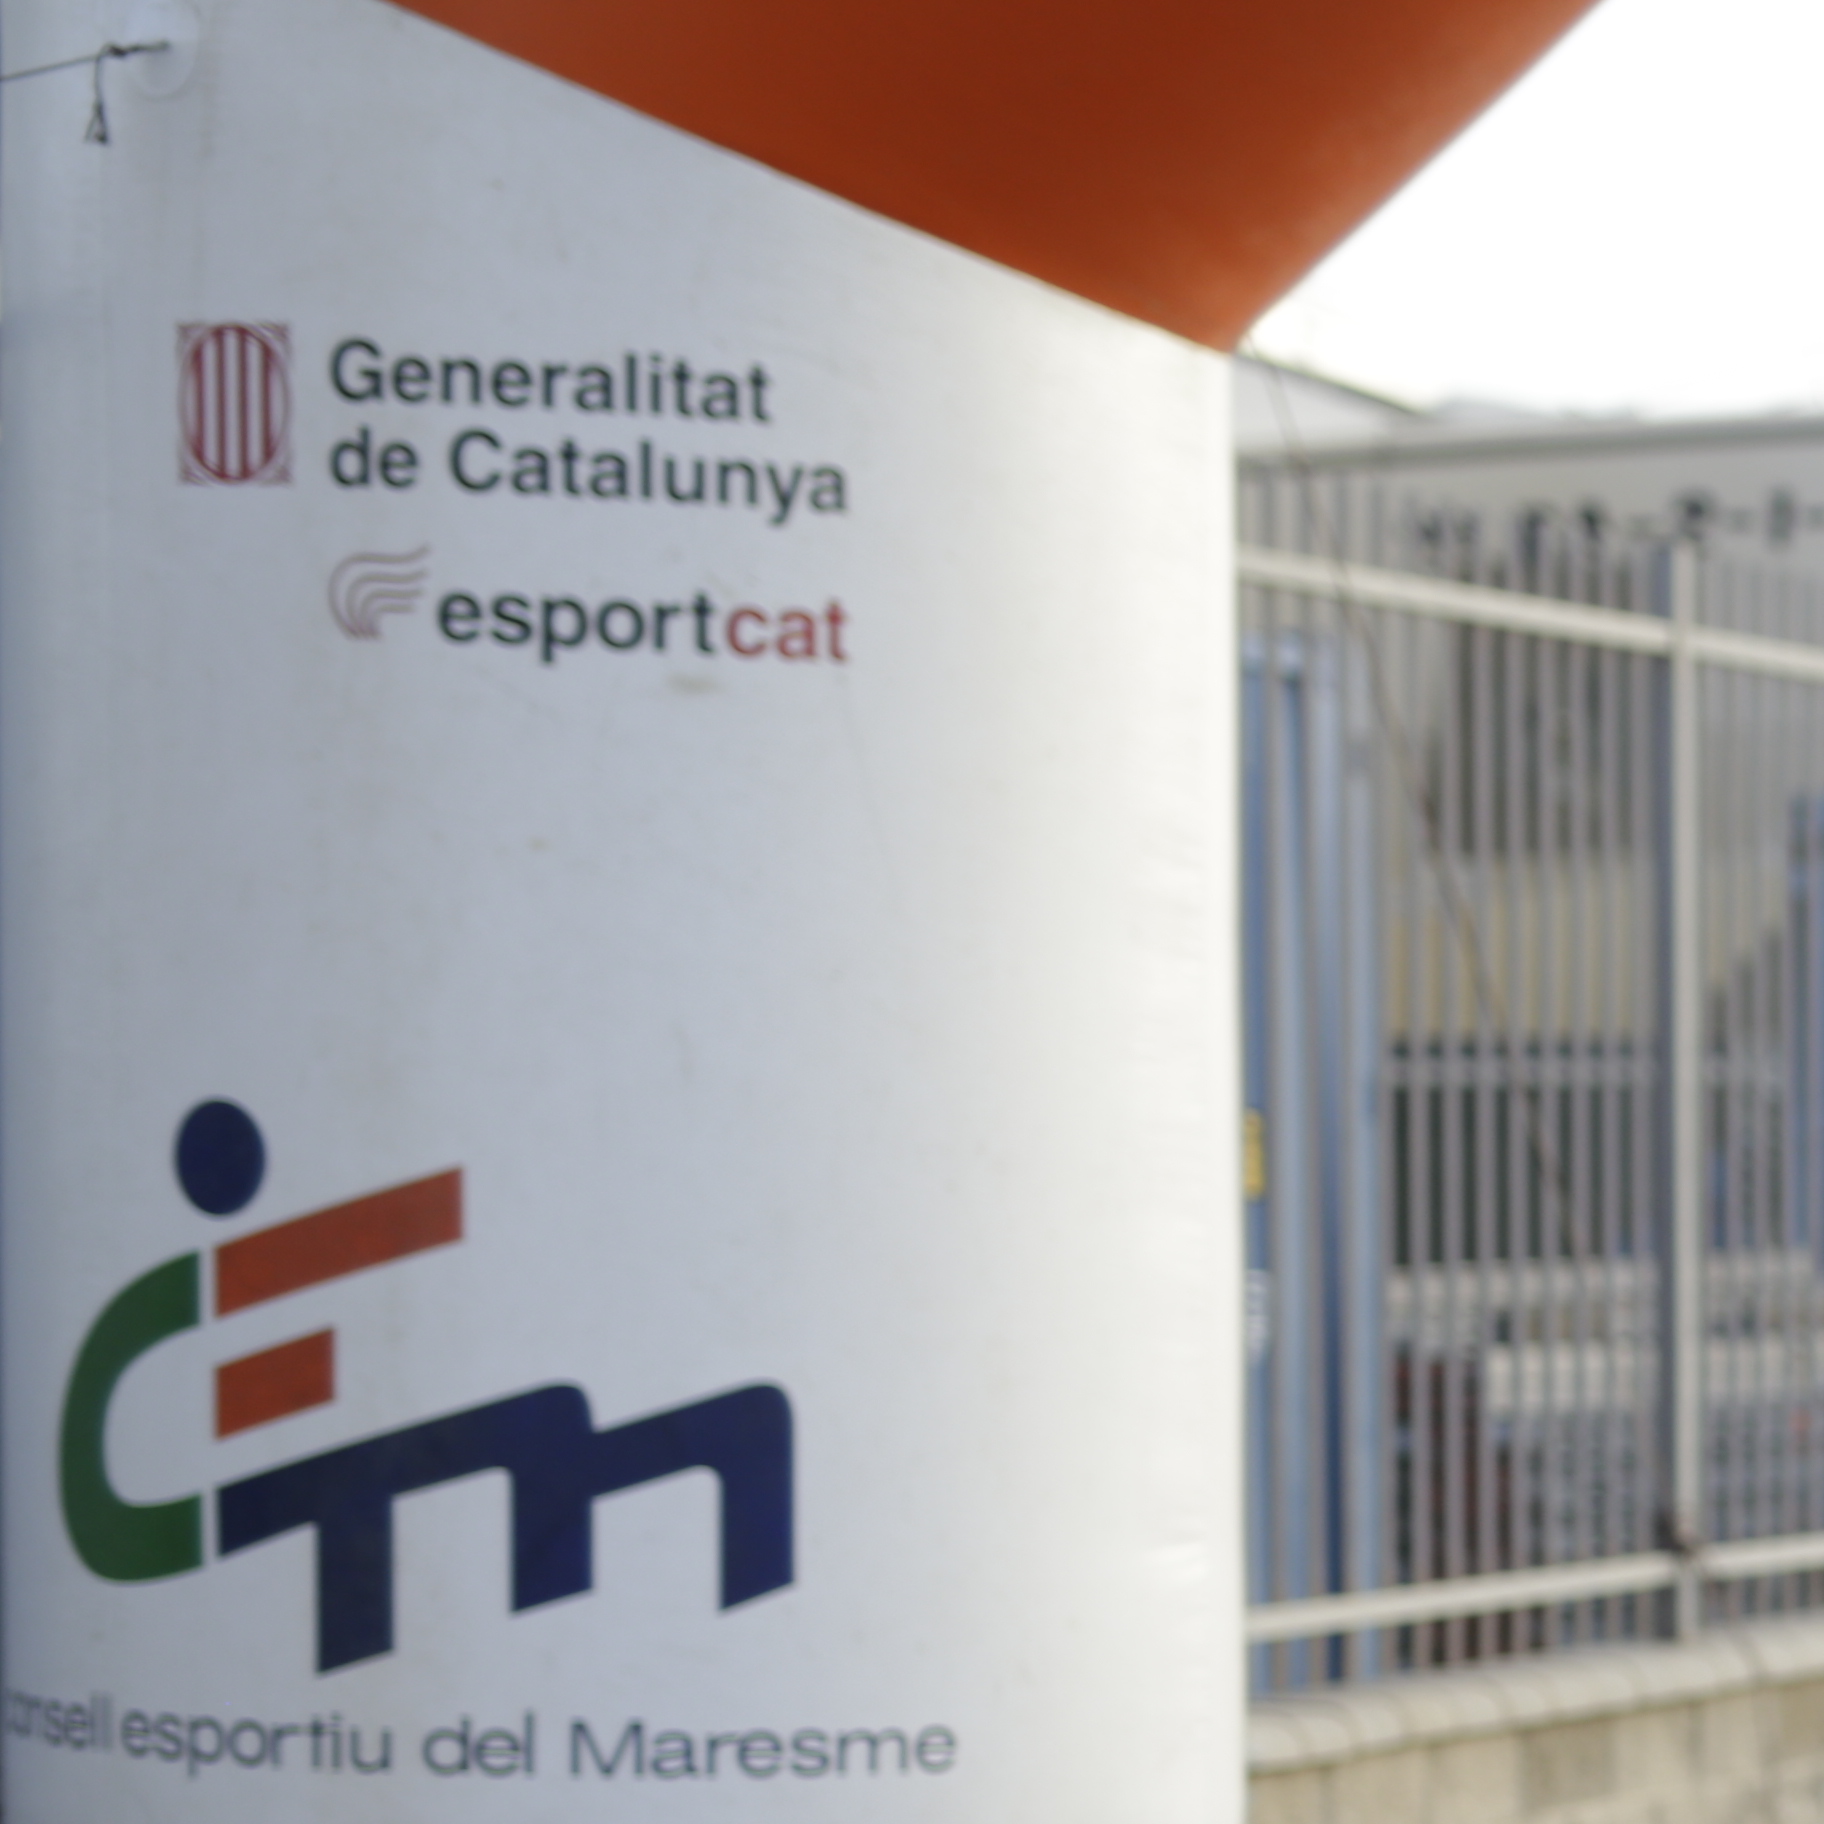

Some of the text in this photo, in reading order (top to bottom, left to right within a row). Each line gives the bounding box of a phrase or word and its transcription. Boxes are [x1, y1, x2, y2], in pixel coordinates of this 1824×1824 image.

[329, 337, 772, 423] Generalitat
[329, 426, 846, 527] de Catalunya
[436, 590, 848, 664] esportcat
[121, 1708, 393, 1778] esportiu
[421, 1712, 536, 1778] del
[569, 1720, 957, 1780] Maresme
